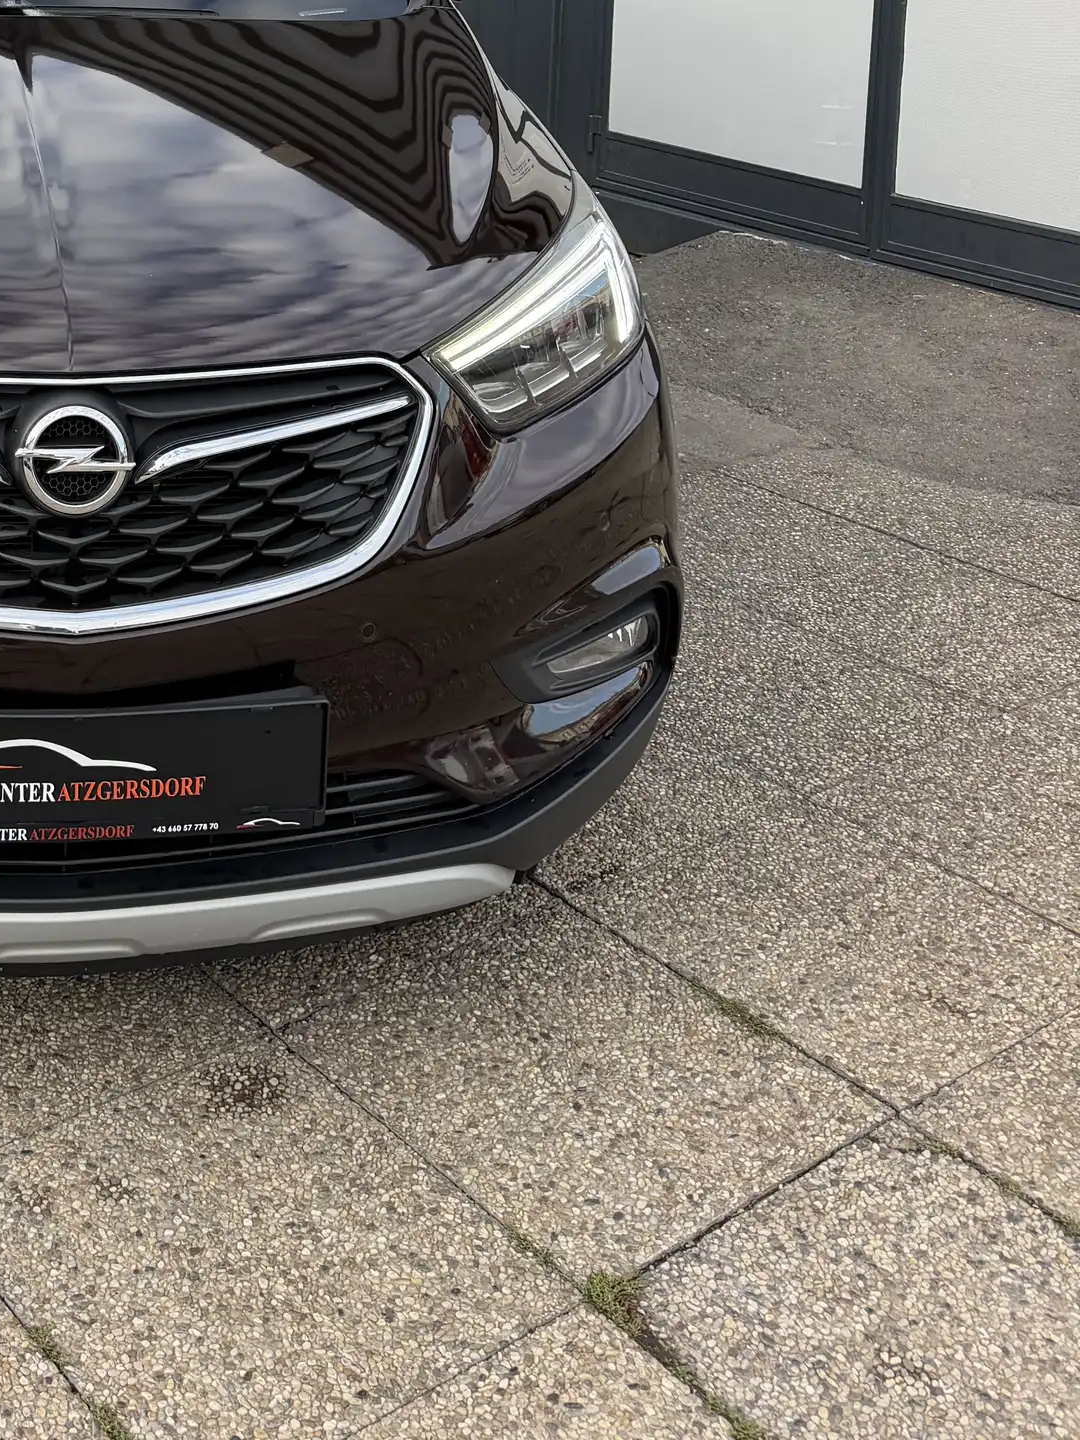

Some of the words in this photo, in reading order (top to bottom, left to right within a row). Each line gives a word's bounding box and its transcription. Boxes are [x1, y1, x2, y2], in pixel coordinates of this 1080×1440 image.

[57, 775, 206, 802] ATZGERSDORF
[29, 824, 135, 841] ATZGERSDORF
[152, 825, 166, 833] +43
[167, 824, 182, 833] 660
[183, 823, 193, 832] 57
[194, 822, 208, 831] 778
[209, 822, 219, 830] 70
